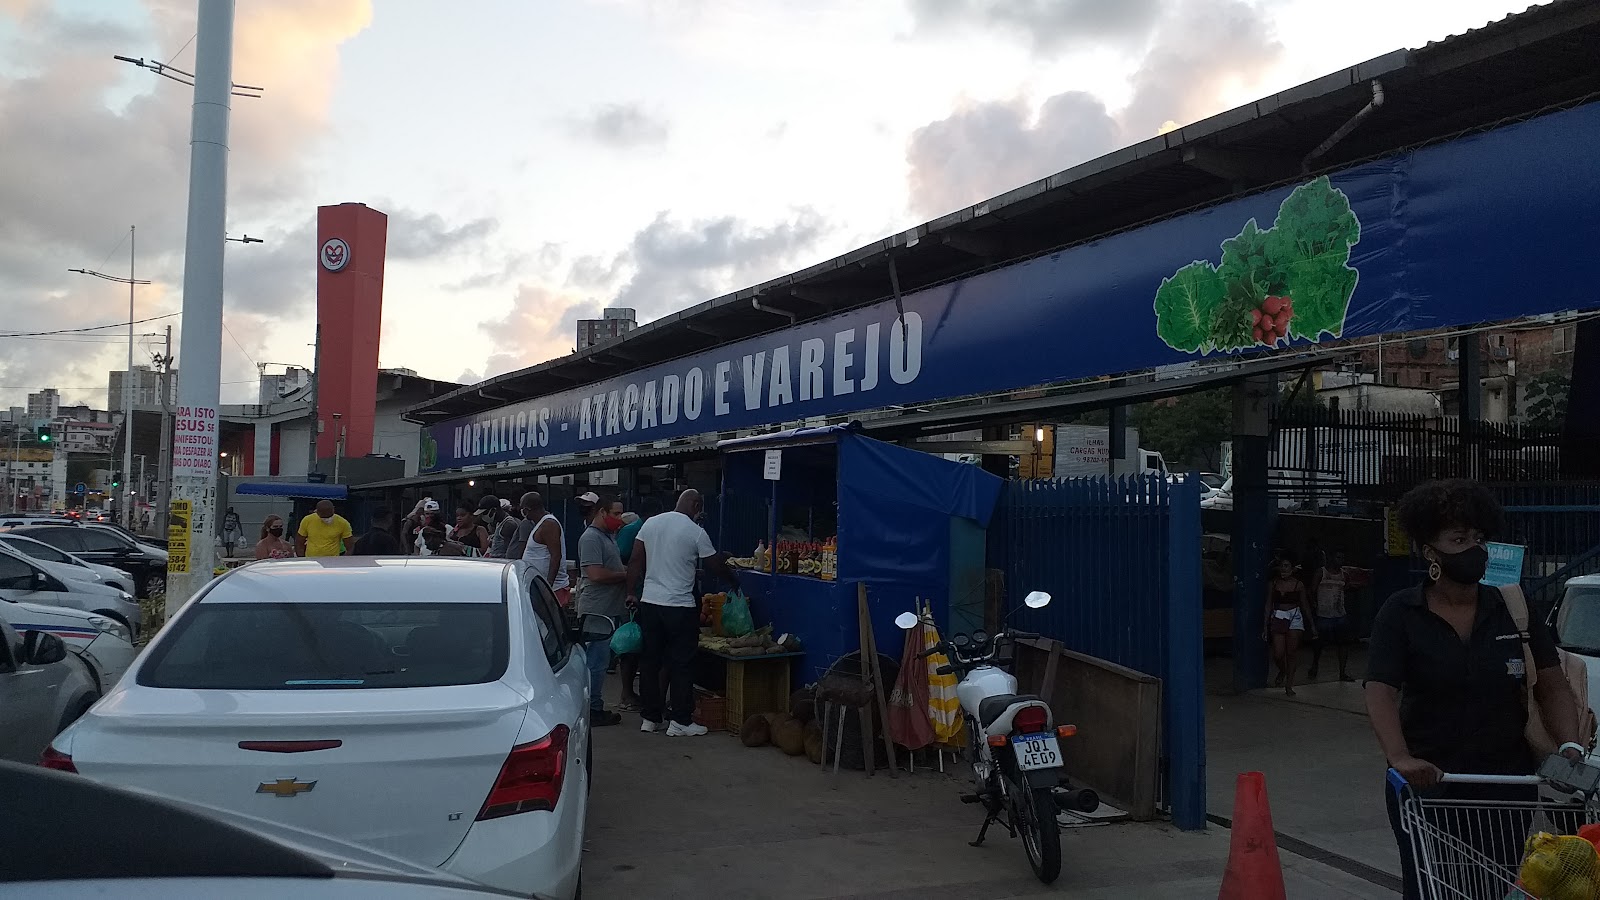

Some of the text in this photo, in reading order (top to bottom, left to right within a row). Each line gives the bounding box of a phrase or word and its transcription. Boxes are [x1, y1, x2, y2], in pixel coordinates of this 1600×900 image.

[453, 407, 551, 459] HORTALIÇAS
[579, 366, 702, 441] ATACADO
[714, 360, 731, 416] E
[742, 311, 923, 410] VAREJO
[195, 407, 215, 419] ISTO
[207, 423, 215, 432] SE
[182, 446, 206, 456] DESFAZER
[1070, 446, 1095, 455] CARGAS
[182, 458, 192, 467] DO
[1025, 739, 1049, 753] JQI
[1024, 751, 1056, 766] 4E09
[448, 811, 463, 821] LT
